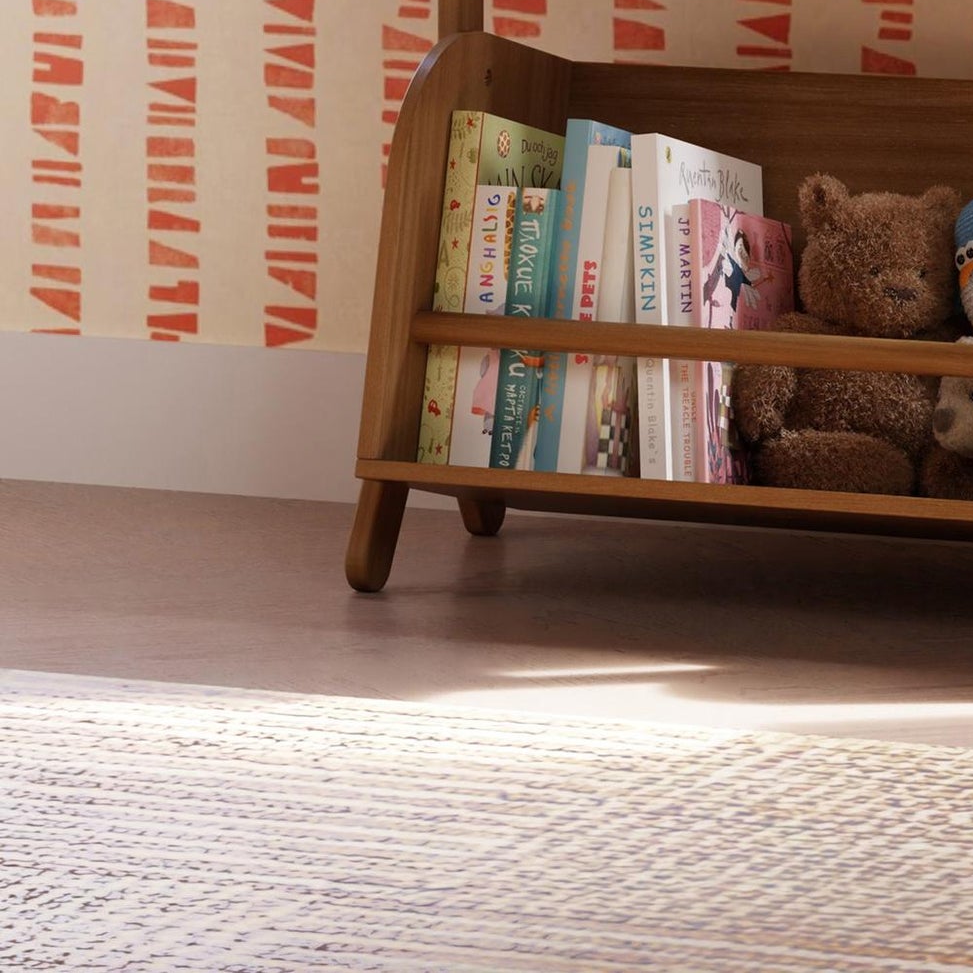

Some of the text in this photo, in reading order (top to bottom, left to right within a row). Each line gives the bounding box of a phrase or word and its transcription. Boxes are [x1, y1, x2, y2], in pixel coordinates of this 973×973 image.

[716, 169, 748, 204] Blake
[479, 194, 501, 303] ANGHALSIG
[580, 260, 597, 307] PETS
[638, 205, 656, 311] SIMPKIN
[678, 217, 692, 313] JP MARTIN
[683, 433, 692, 477] TROUBLE
